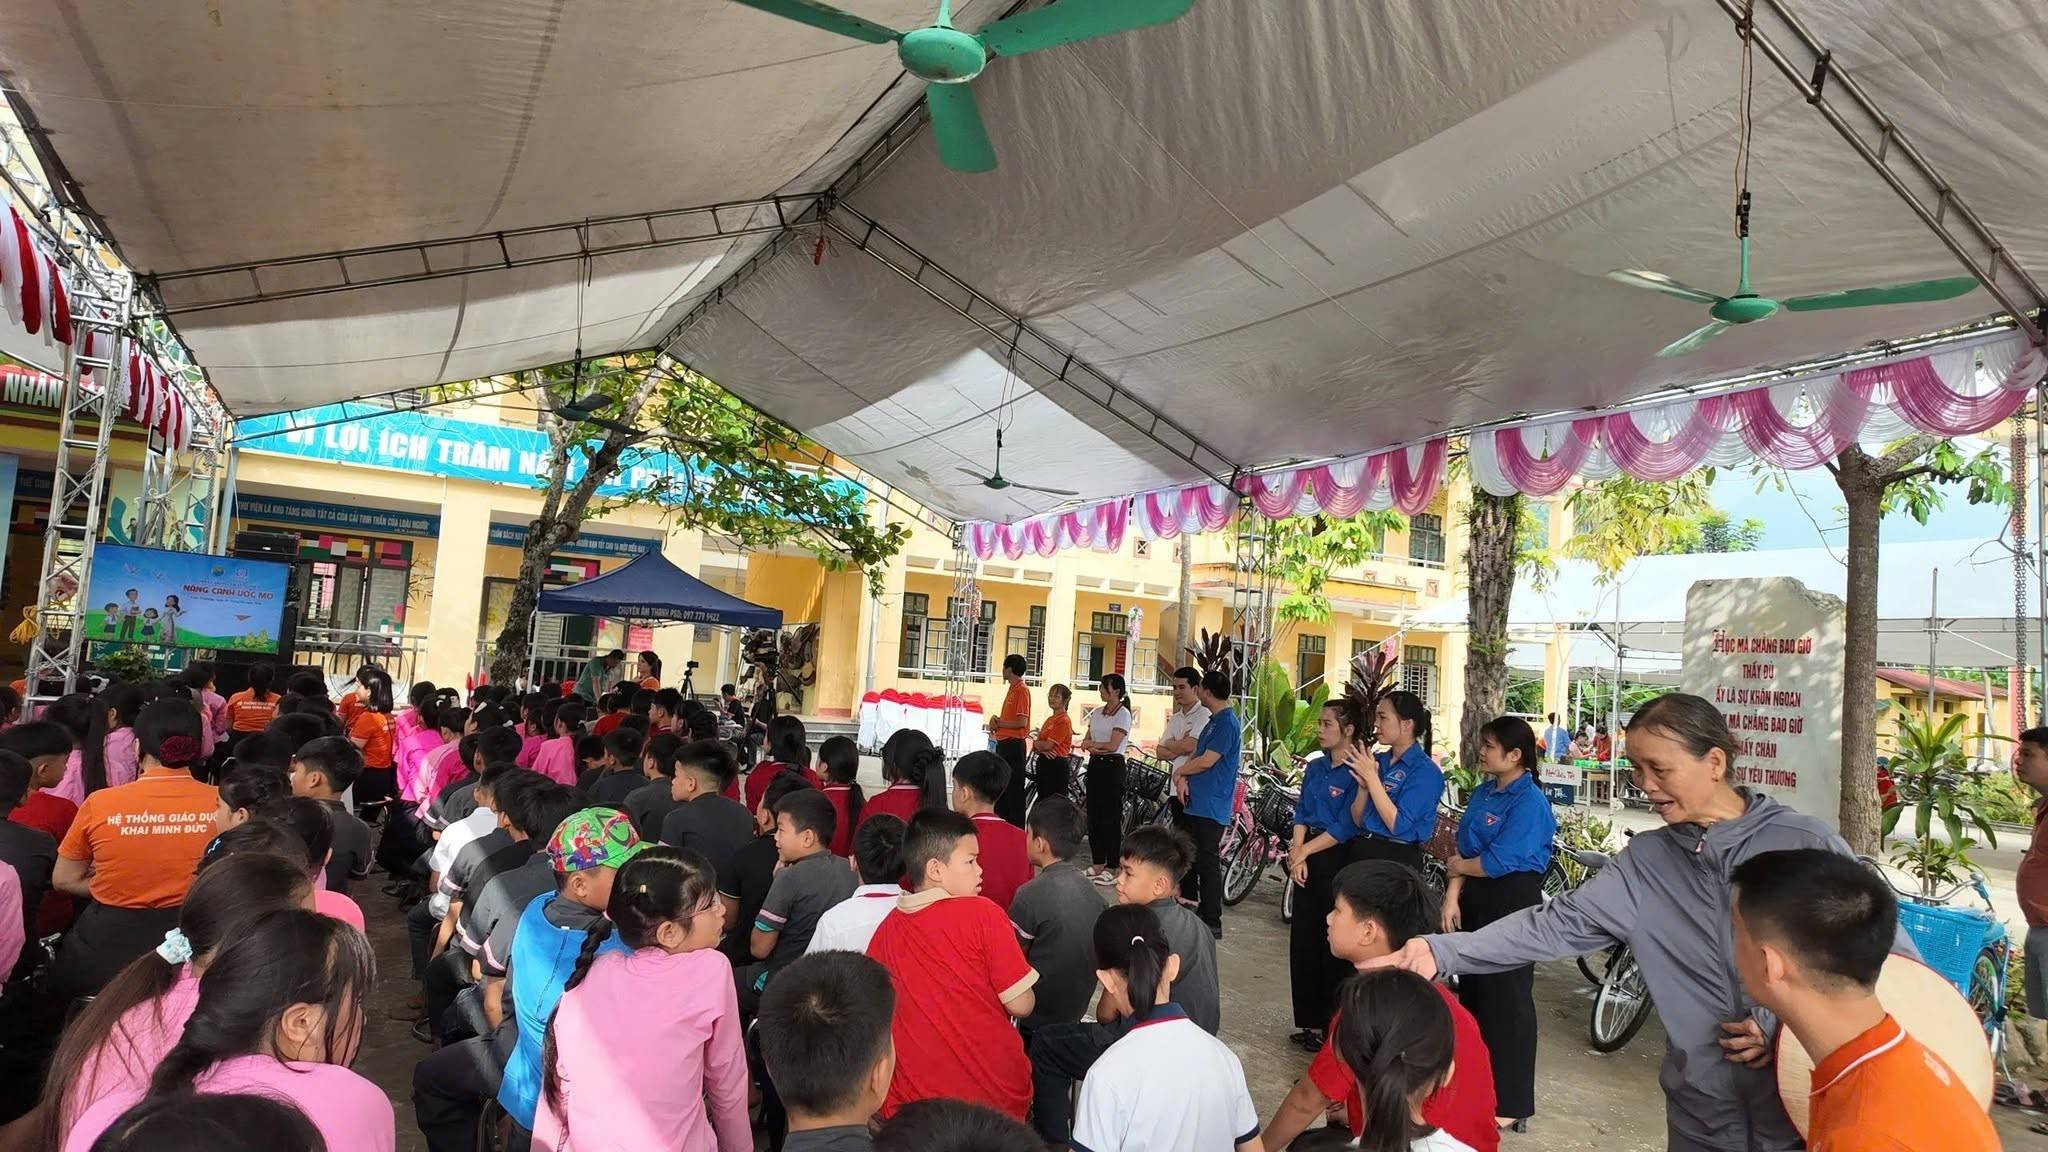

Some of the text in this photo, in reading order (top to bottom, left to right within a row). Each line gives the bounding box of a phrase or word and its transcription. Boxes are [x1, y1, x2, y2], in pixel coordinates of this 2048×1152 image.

[3, 372, 63, 409] NHÂN
[325, 423, 369, 454] LỢI
[379, 425, 428, 461] ÍCH
[437, 439, 511, 472] TRĂM
[1737, 636, 1749, 653] MÀ
[1779, 638, 1796, 654] BAO
[1797, 636, 1813, 655] GIỜ
[1743, 661, 1775, 679] THẤY ĐỦ
[1716, 684, 1801, 708] ẤY LÀ SỰ KHÔN NGOAN
[1728, 712, 1741, 729] MÀ
[1771, 717, 1787, 733] BAO
[1789, 715, 1804, 734] GIỜ
[1755, 740, 1777, 759] CHÁN
[1736, 765, 1797, 788] SỰ YÊU THƯƠNG
[107, 815, 122, 826] HỆ
[127, 809, 165, 824] THỐNG
[169, 810, 196, 823] GIÁO
[121, 822, 207, 836] KHAI MINH ĐỨC
